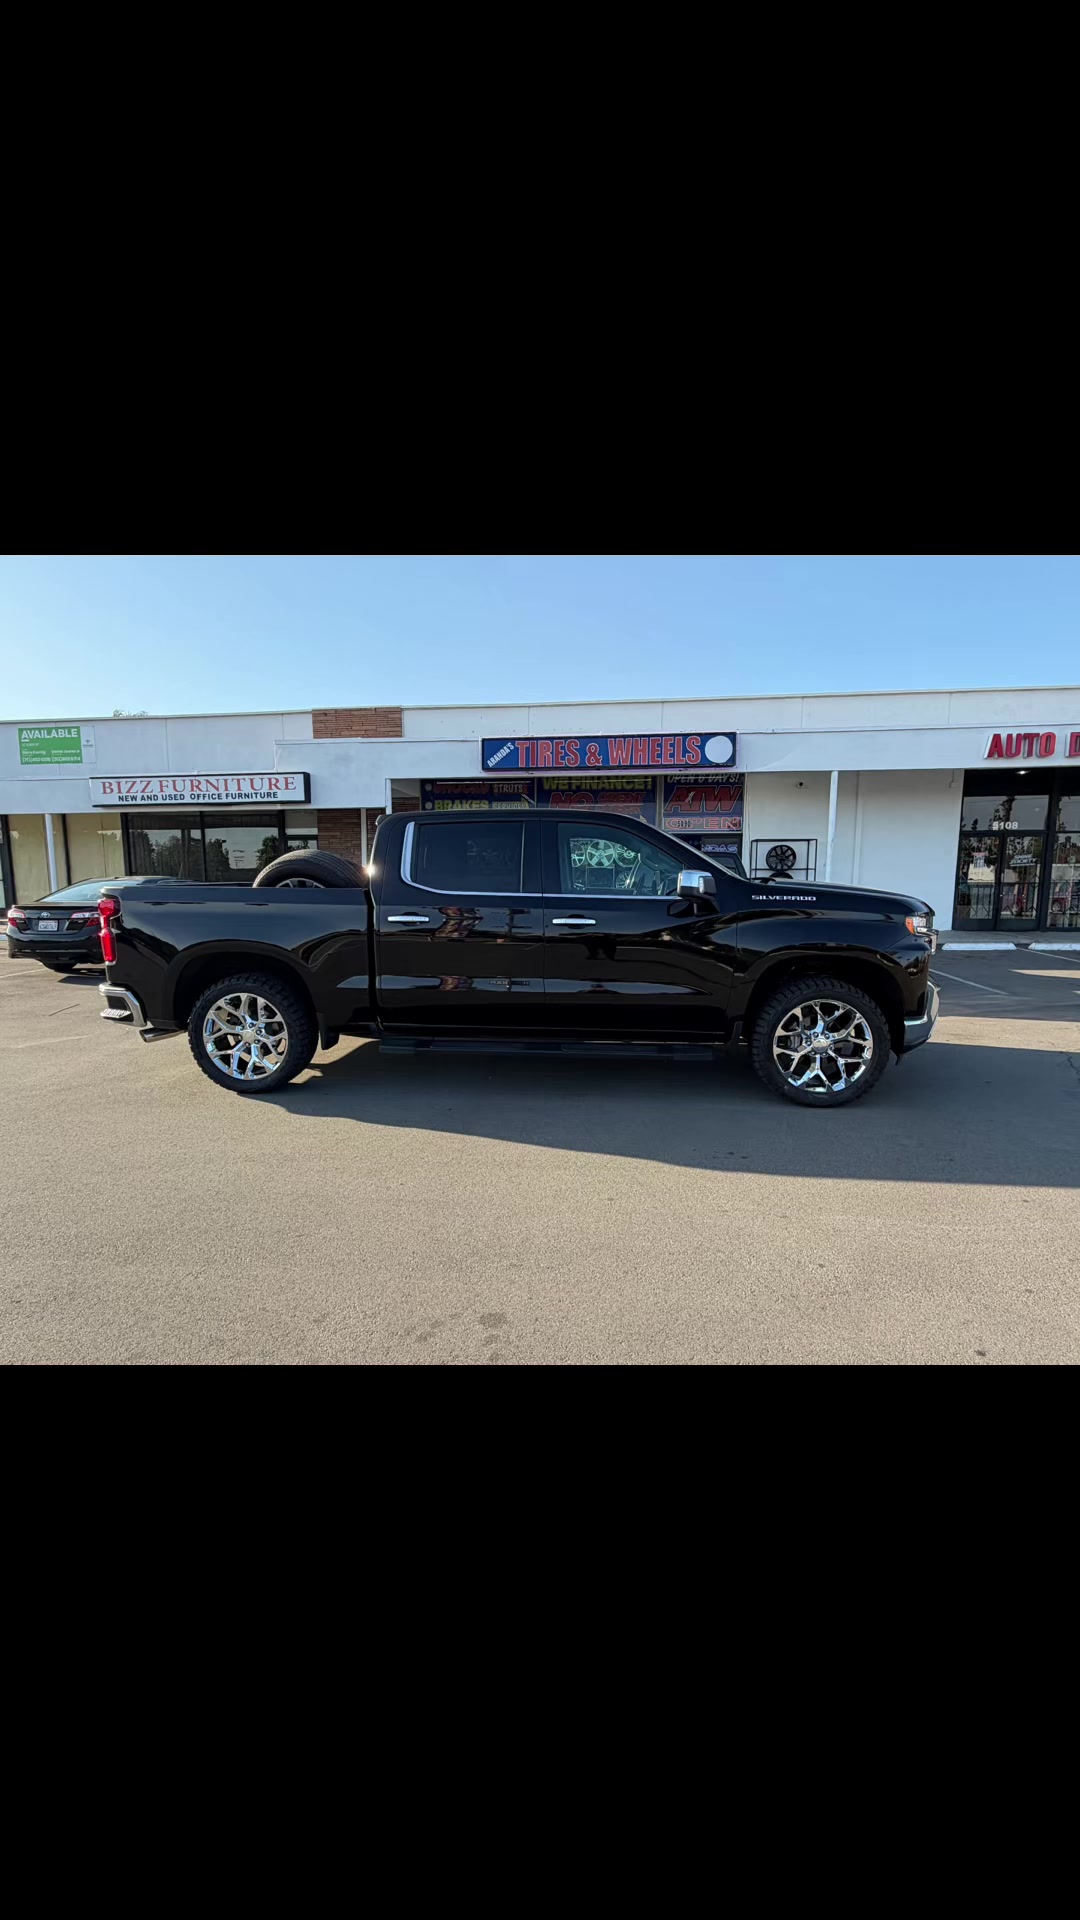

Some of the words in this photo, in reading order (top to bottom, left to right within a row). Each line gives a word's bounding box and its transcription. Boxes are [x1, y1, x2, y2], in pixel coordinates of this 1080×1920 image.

[21, 729, 78, 739] AVAILABLE
[515, 740, 580, 767] TIRES
[585, 742, 603, 767] &
[608, 736, 701, 766] WHEELS
[985, 732, 1057, 759] AUTO
[487, 742, 514, 767] ARANDA'S
[101, 780, 153, 794] BIZZ
[158, 776, 297, 793] FURNITURE
[493, 784, 523, 793] STRUTS
[543, 776, 569, 790] WE
[140, 794, 159, 802] AND
[161, 793, 185, 801] USED
[190, 792, 223, 801] OFFICE
[225, 791, 279, 800] FURNITURE
[434, 800, 489, 810] BRAKES
